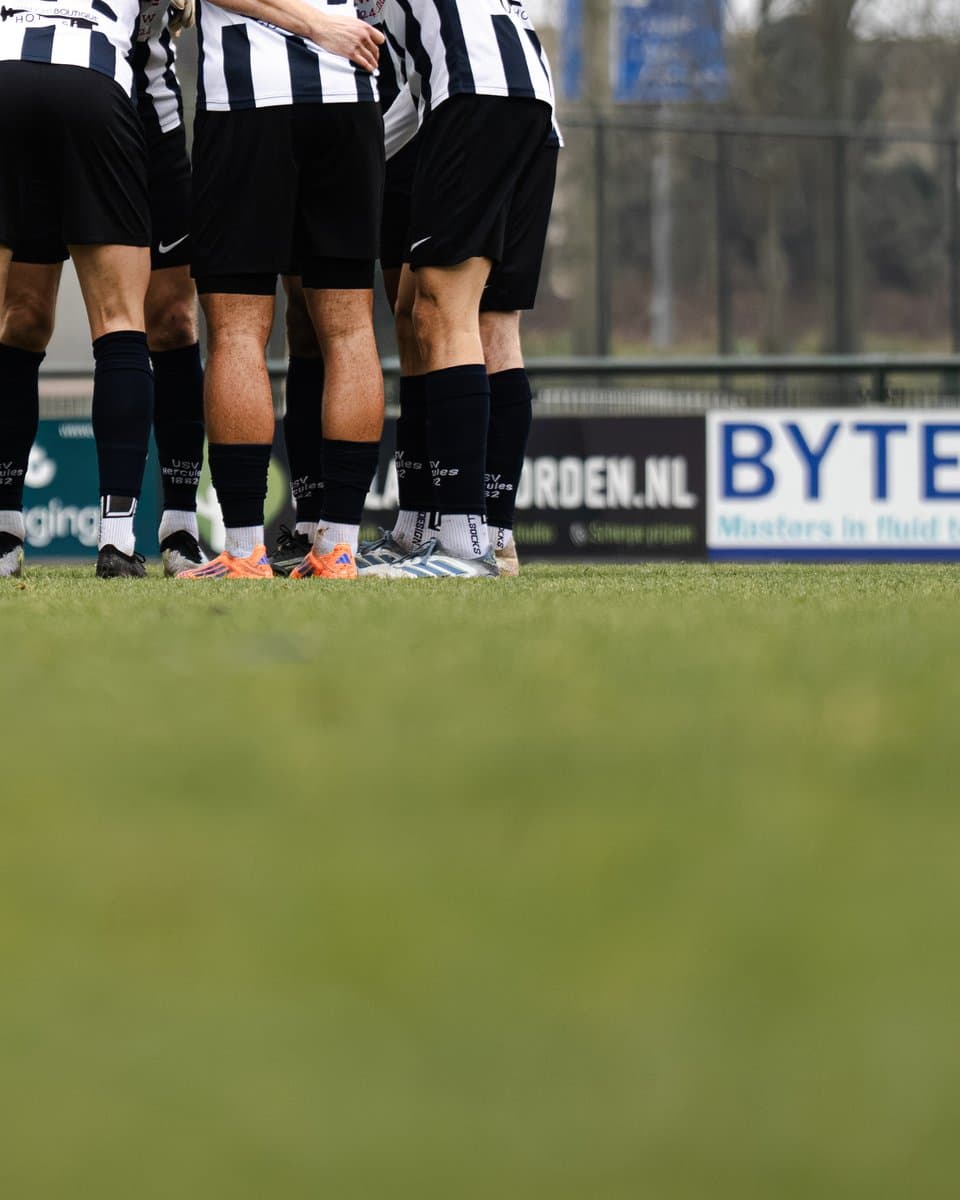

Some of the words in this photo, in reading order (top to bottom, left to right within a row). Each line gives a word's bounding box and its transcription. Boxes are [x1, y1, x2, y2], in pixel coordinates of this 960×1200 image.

[486, 481, 513, 491] ules
[718, 515, 833, 539] Masters
[841, 515, 866, 539] in
[876, 514, 938, 539] fluid
